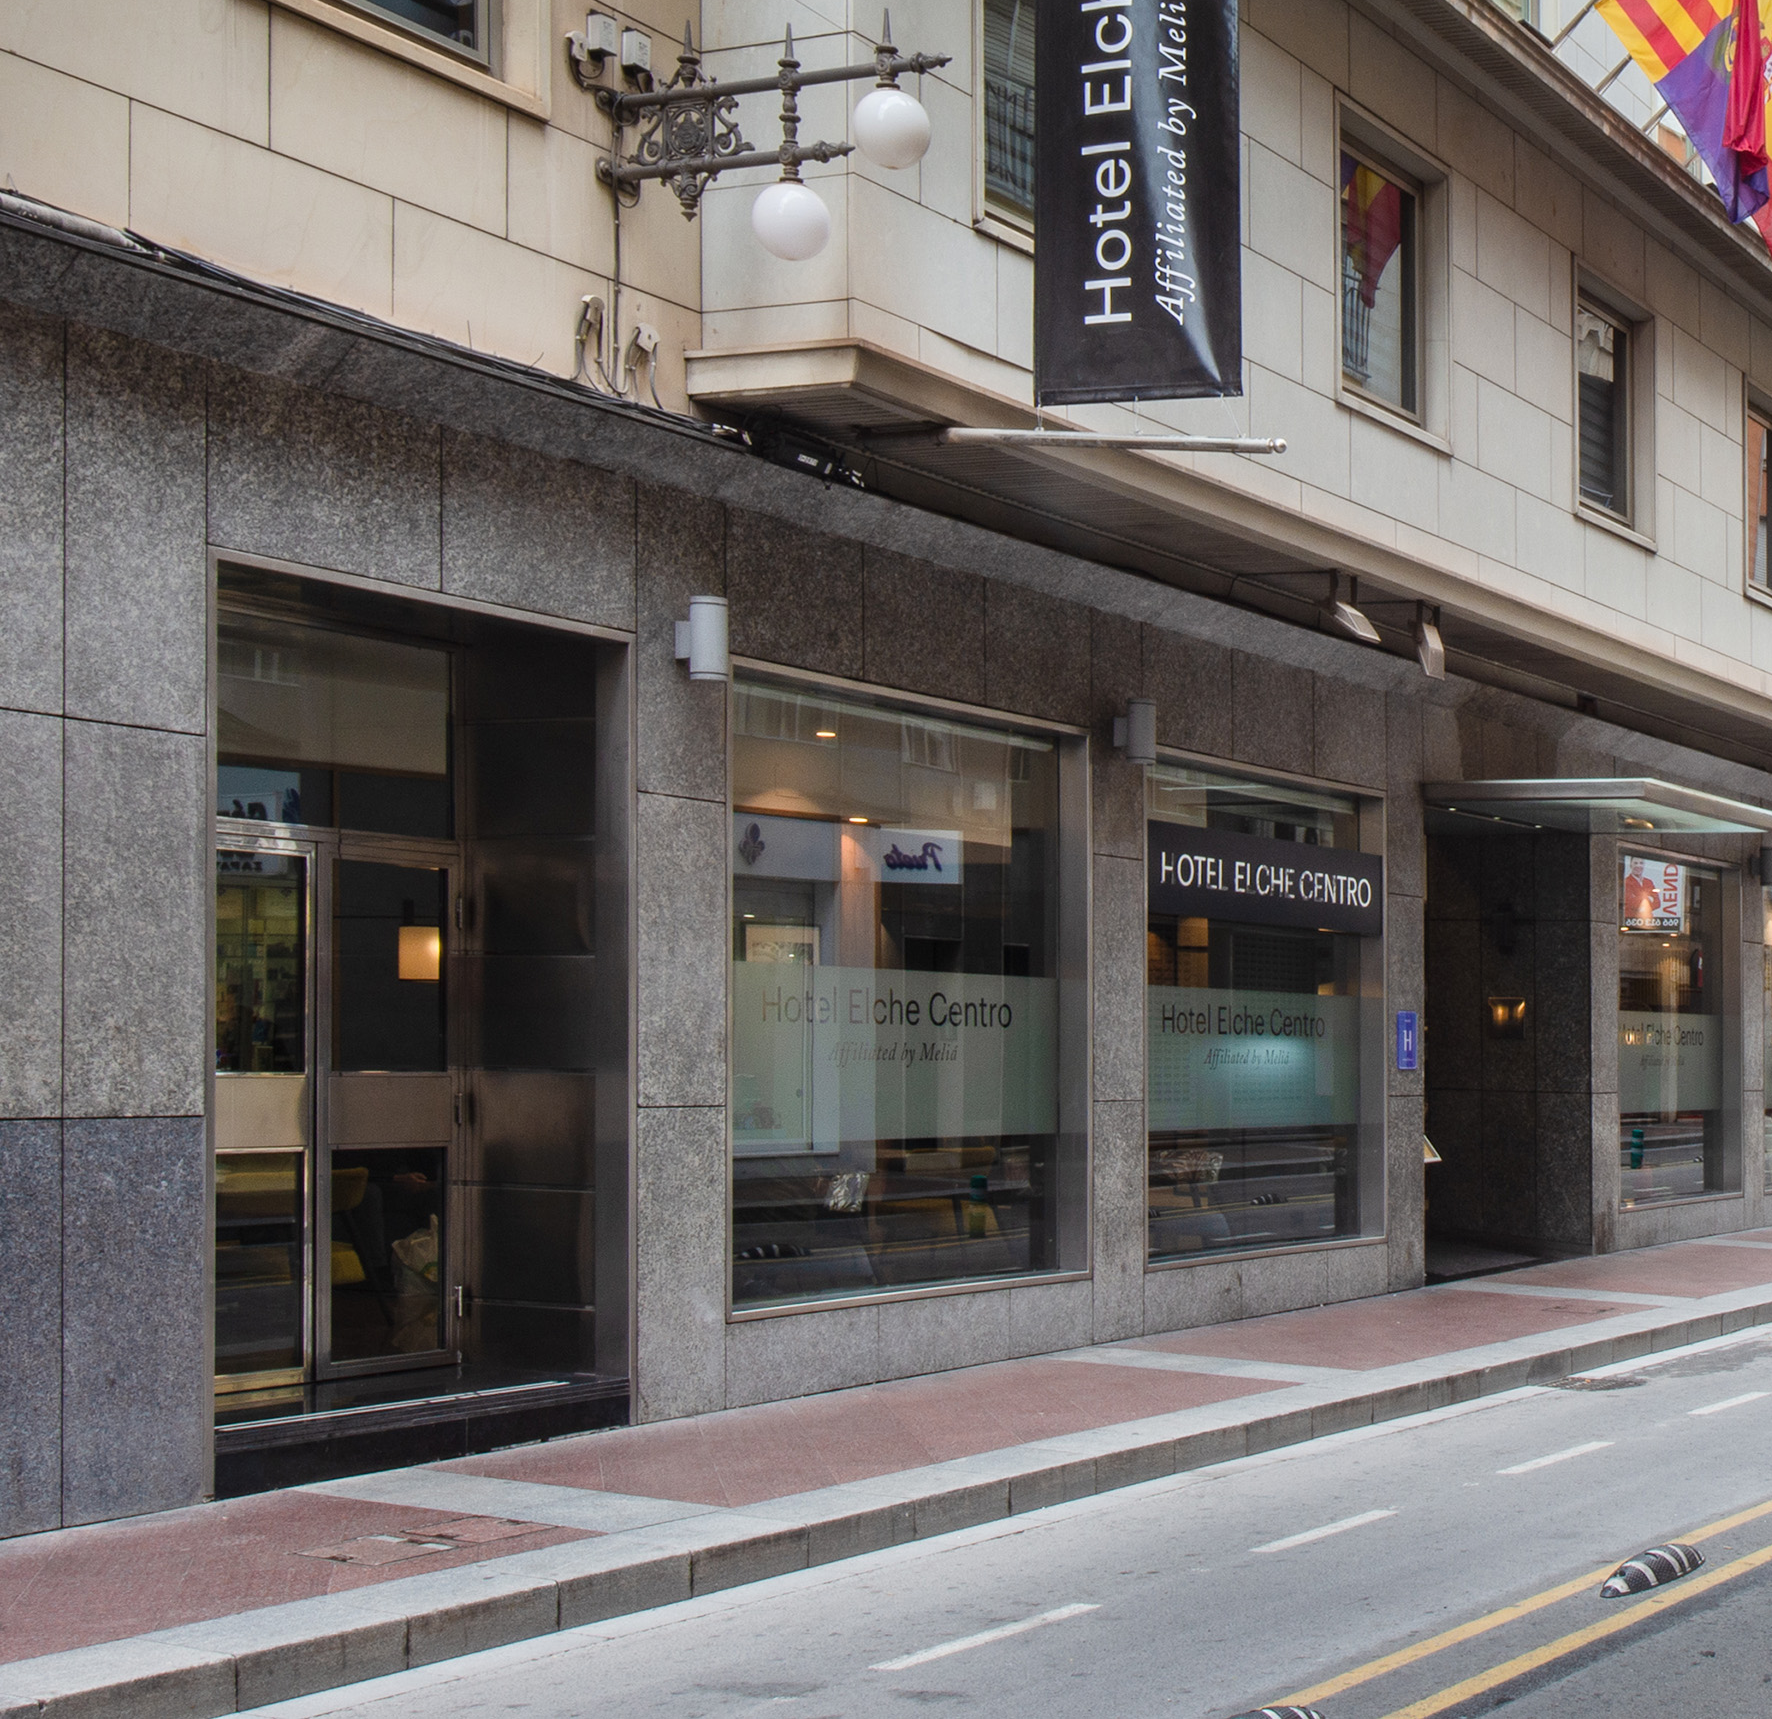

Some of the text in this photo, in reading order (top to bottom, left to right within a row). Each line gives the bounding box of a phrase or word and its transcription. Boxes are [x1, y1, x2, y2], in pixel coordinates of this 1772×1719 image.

[1157, 97, 1197, 137] by
[1081, 141, 1133, 326] Hotel
[1155, 145, 1197, 326] Affiliated
[1160, 851, 1372, 908] HOTEL ELCHE CENTRO
[761, 985, 1013, 1028] Hotel Elche Centro
[1162, 1004, 1326, 1038] Hotel Elche Centro
[900, 1042, 916, 1068] by
[919, 1042, 958, 1062] Meliá
[1203, 1048, 1250, 1071] Affiliated
